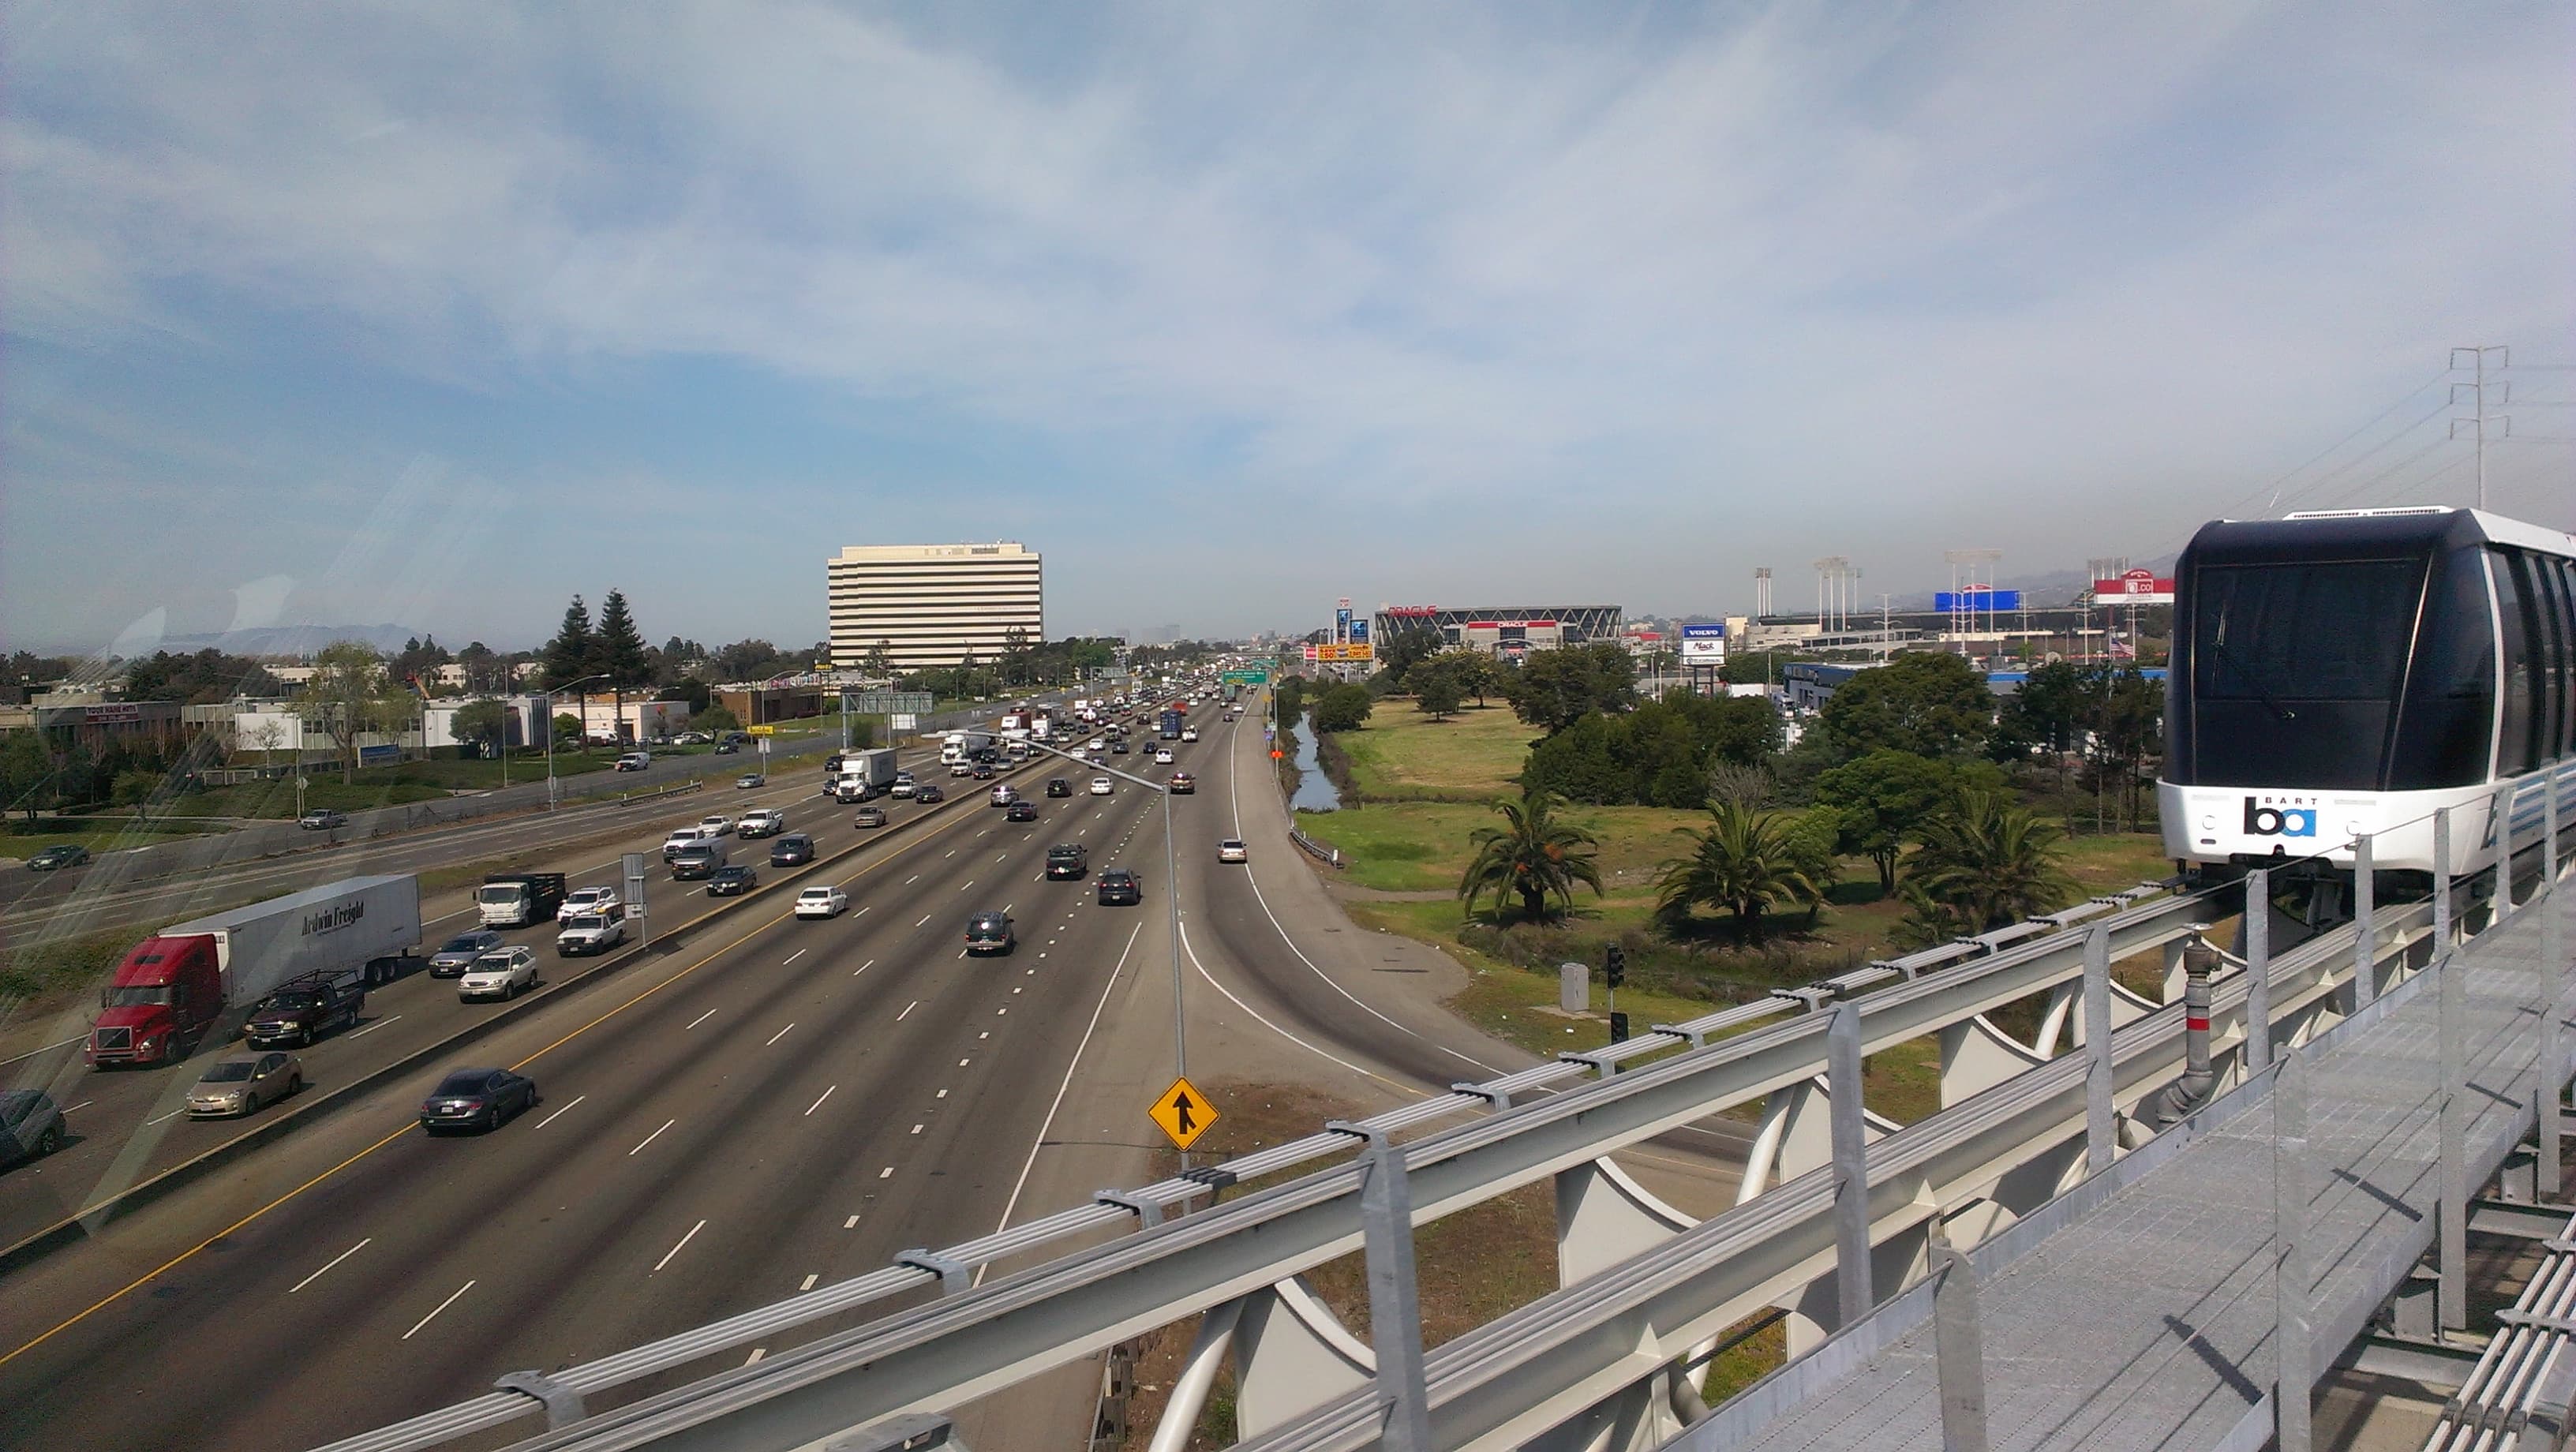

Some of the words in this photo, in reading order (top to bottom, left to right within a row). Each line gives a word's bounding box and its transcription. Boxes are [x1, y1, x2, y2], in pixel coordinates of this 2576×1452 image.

[1388, 605, 1436, 616] ORACLE
[1693, 642, 1714, 651] Mack
[2265, 796, 2317, 805] BART
[301, 909, 332, 937] Ardwin
[334, 900, 364, 924] Freight
